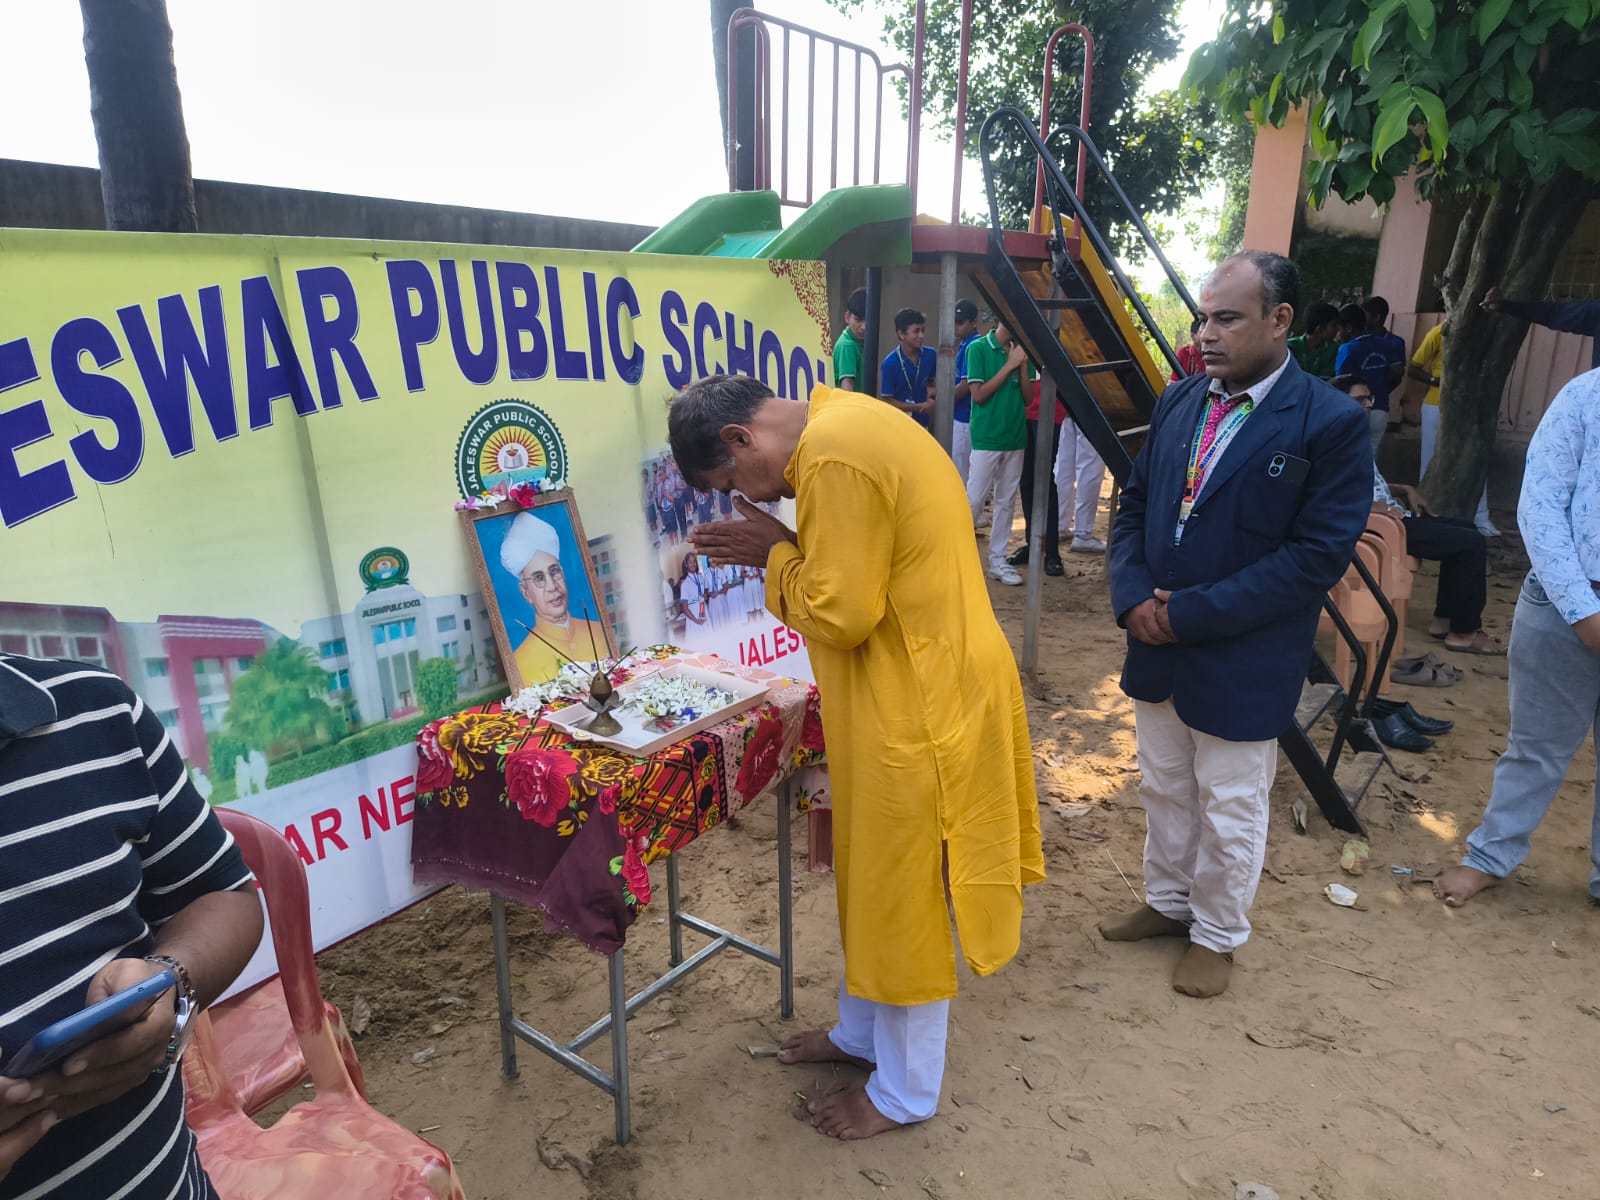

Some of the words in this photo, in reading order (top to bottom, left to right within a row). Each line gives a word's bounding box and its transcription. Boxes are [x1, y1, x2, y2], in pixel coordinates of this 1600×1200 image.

[386, 259, 645, 393] PUBLIC
[466, 420, 493, 490] JALESWAR
[493, 411, 537, 428] PUBLIC
[537, 425, 559, 478] SCHOOL
